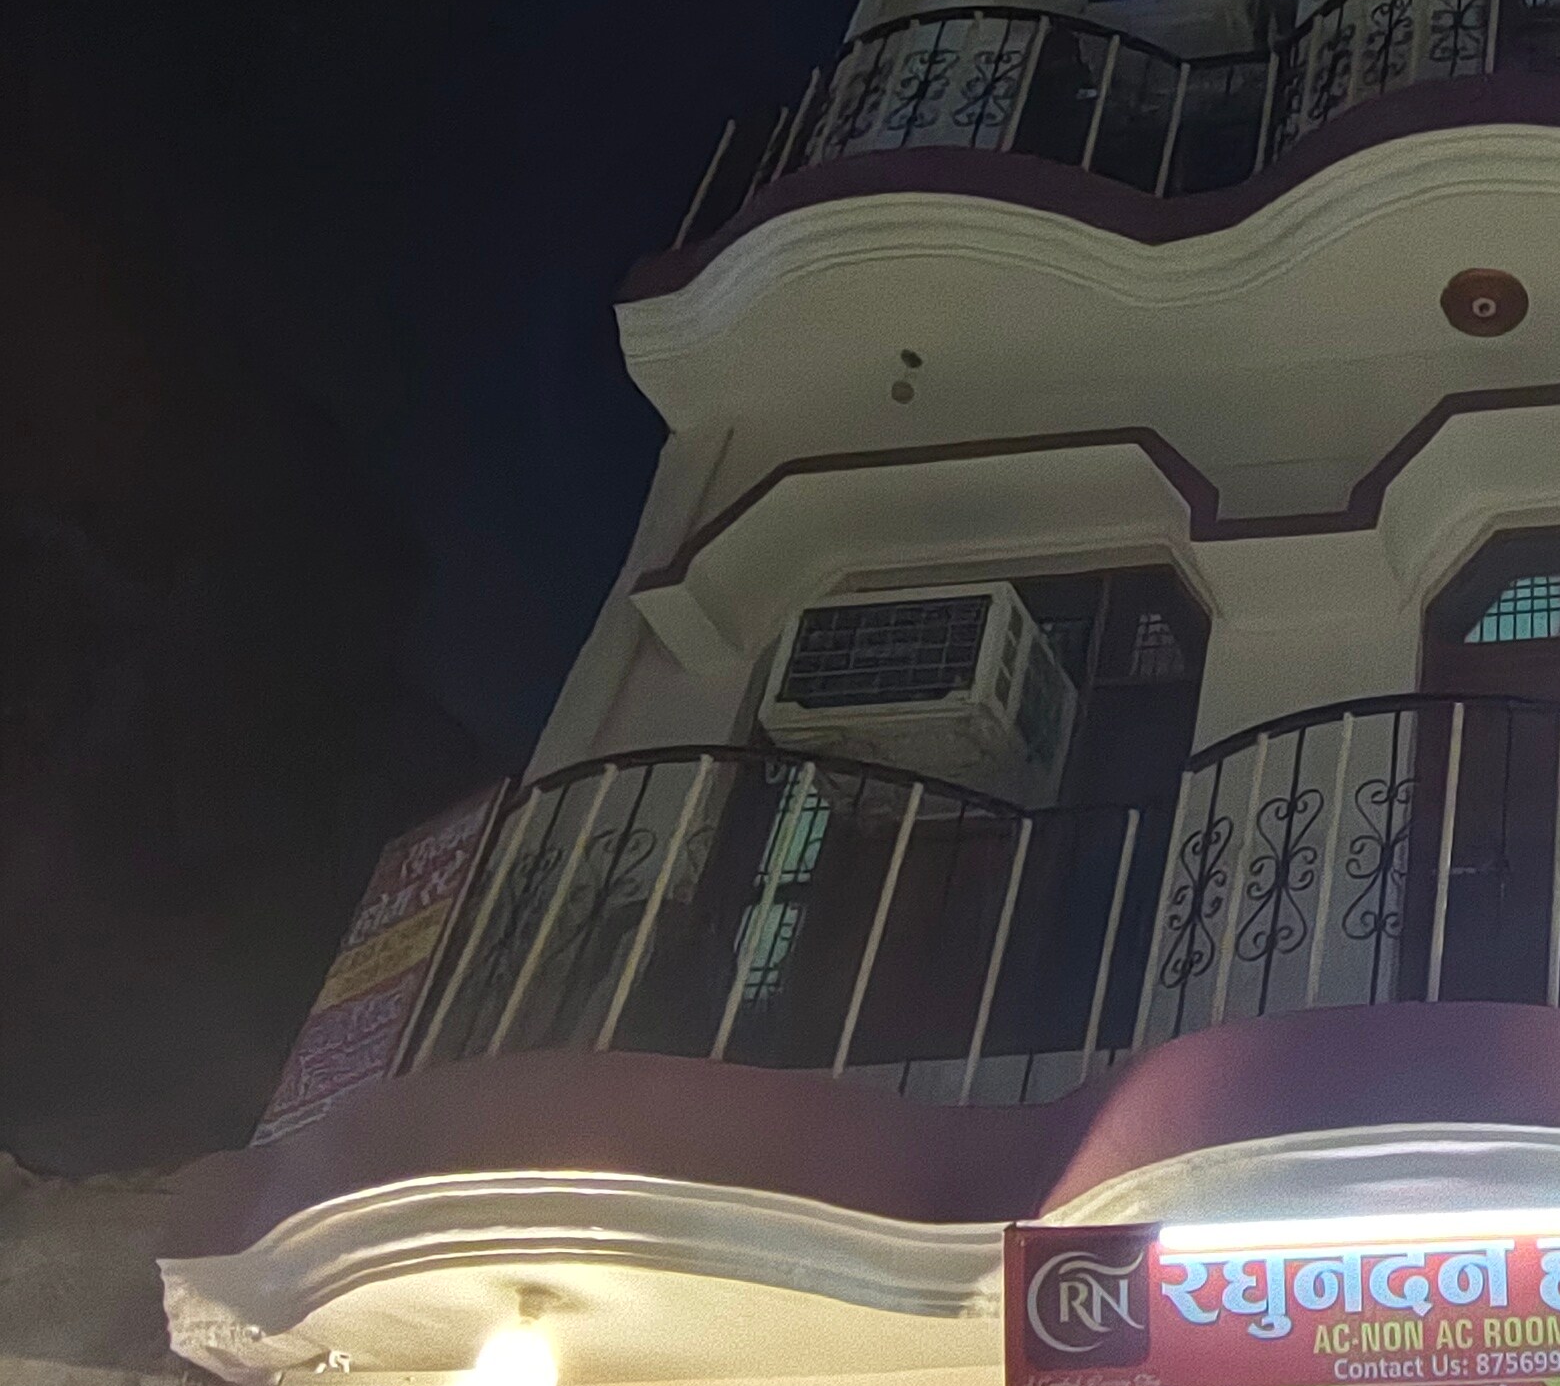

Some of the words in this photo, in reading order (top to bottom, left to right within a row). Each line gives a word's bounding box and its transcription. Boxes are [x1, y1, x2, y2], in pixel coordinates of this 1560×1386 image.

[1436, 1319, 1473, 1350] AC
[1333, 1355, 1424, 1381] Contact
[1431, 1354, 1468, 1377] Us:
